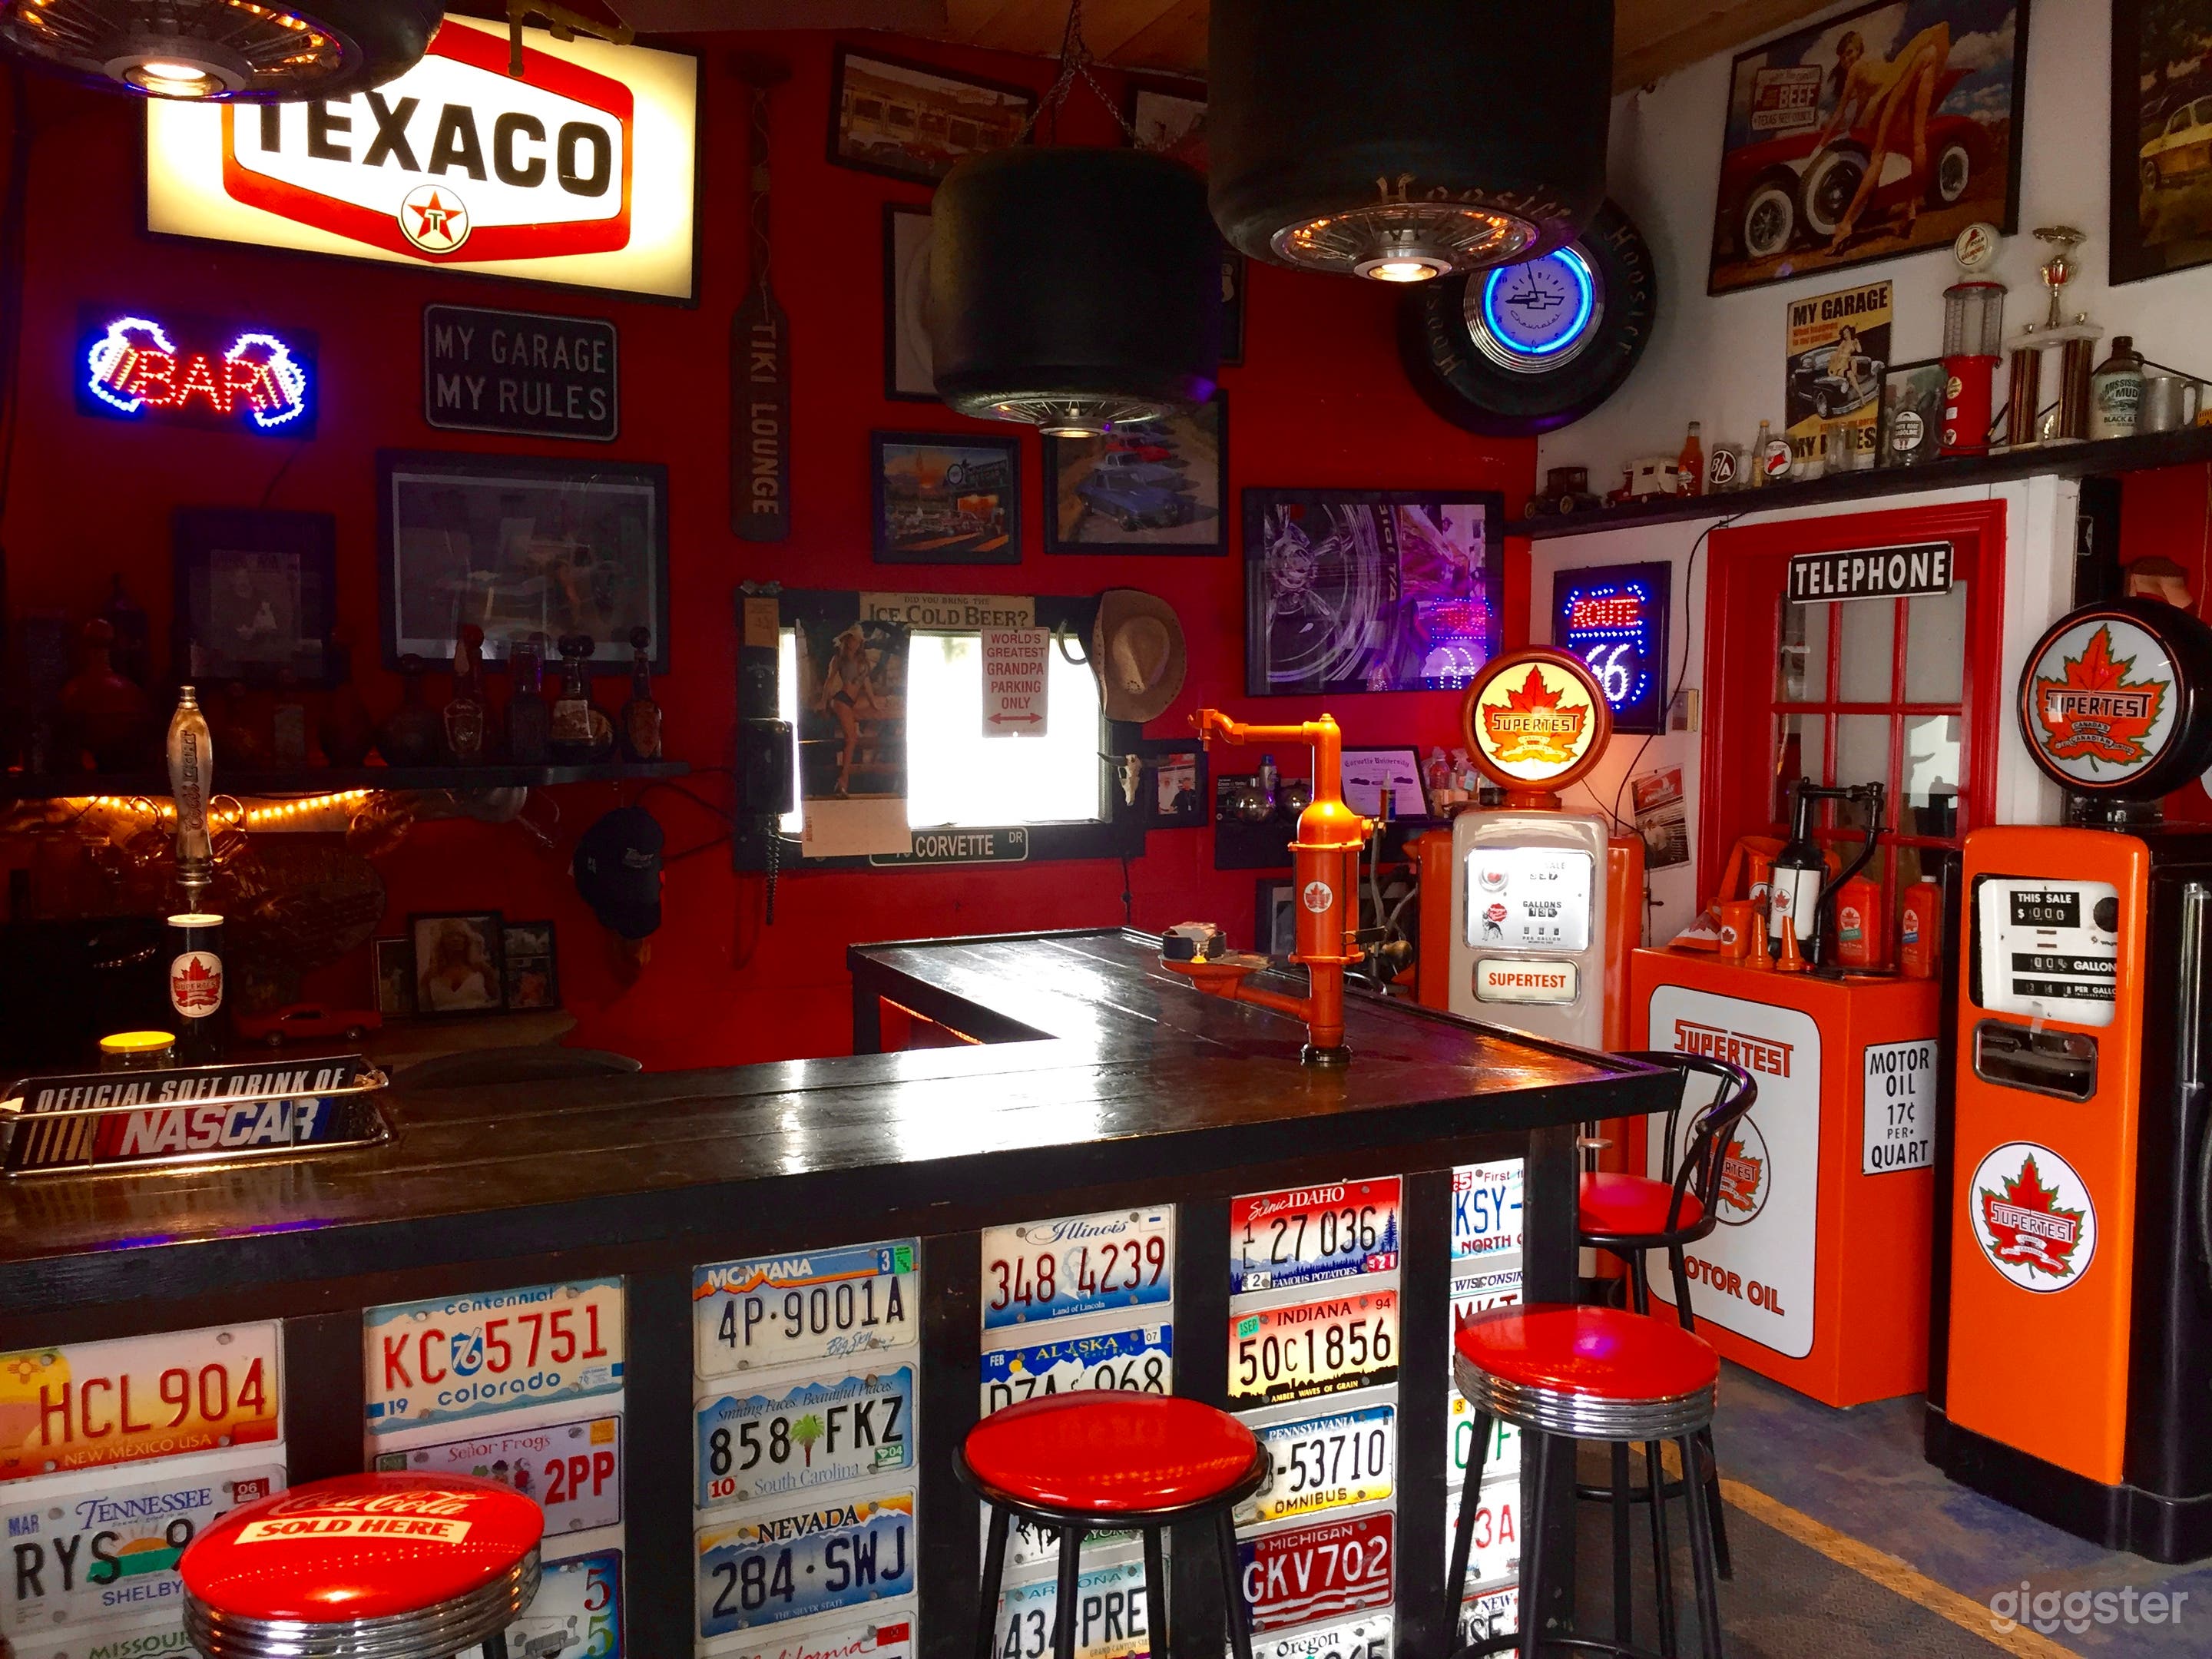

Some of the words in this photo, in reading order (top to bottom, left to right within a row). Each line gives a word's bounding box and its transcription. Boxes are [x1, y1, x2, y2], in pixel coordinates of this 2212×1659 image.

[1780, 84, 1817, 108] BEEF
[260, 91, 611, 197] TEXACO
[1793, 303, 1817, 326] MY
[1821, 286, 1887, 321] GARAGE
[435, 323, 475, 361] MY
[491, 328, 606, 374] GARAGE
[750, 320, 777, 383] TIKI
[138, 350, 264, 412] BAR
[2115, 389, 2137, 397] MUD
[437, 373, 486, 411] MY
[499, 378, 607, 421] RULES
[750, 402, 780, 515] LOUNGE
[1796, 551, 1945, 595] TELEPHONE
[942, 597, 969, 605] BRING
[1574, 598, 1638, 628] ROUTE
[869, 604, 900, 621] ICE
[906, 604, 959, 624] COLD
[965, 606, 1028, 628] BEER?
[991, 634, 1041, 644] WORLD'S
[987, 647, 1045, 658] GREATEST
[987, 663, 1043, 675] GRANDPA
[991, 680, 1041, 693] PARKING
[1002, 697, 1031, 710] ONLY
[1494, 714, 1579, 732] SUPERTEST
[916, 834, 994, 858] CORVETTE
[1008, 831, 1023, 843] DR
[2018, 893, 2041, 903] THIS
[2046, 893, 2071, 904] SALE
[1488, 972, 1566, 988] SUPERTEST
[1674, 1019, 1794, 1078] SUPERTEST
[1870, 1048, 1929, 1075] MOTOR
[36, 1088, 149, 1113] OFFICIAL
[159, 1077, 217, 1103] SOFT
[230, 1071, 309, 1098] DRINK
[314, 1068, 346, 1091] OF
[1886, 1074, 1916, 1096] OIL
[120, 1098, 321, 1156] NASCAR
[1887, 1102, 1915, 1126] 17¢
[1872, 1140, 1929, 1169] QUART
[1459, 1173, 1472, 1190] 5
[1484, 1171, 1510, 1183] First
[1288, 1187, 1345, 1209] IDAHO
[1025, 1217, 1128, 1246] Illinois
[1270, 1214, 1309, 1265] 27
[1320, 1206, 1376, 1257] 036
[1992, 1202, 2075, 1243] SUPERTEST
[1462, 1235, 1512, 1254] NORTH
[708, 1259, 813, 1287] MONTANA
[881, 1250, 890, 1271] 3
[990, 1253, 1055, 1310] 348
[1078, 1236, 1164, 1298] 4239
[1253, 1274, 1260, 1287] 2
[1273, 1273, 1310, 1288] FAMOUS
[1312, 1266, 1358, 1282] POTATOES
[1684, 1255, 1743, 1299] OTOR
[1747, 1280, 1785, 1316] OIL
[444, 1286, 554, 1316] centennial
[1052, 1306, 1070, 1316] Land
[1071, 1305, 1078, 1313] of
[1080, 1301, 1105, 1313] Lincoln
[1277, 1301, 1352, 1326] INDIANA
[1376, 1297, 1391, 1310] 94
[383, 1328, 447, 1392] KC
[485, 1305, 608, 1373] 5751
[1146, 1332, 1157, 1343] 07
[990, 1355, 1005, 1367] FEB
[389, 1398, 409, 1416] 19
[438, 1372, 561, 1406] colorado
[717, 1404, 763, 1422] Smiling
[766, 1399, 798, 1413] Faces.
[803, 1384, 855, 1404] Beautiful
[859, 1380, 894, 1398] Places.
[1271, 1392, 1295, 1402] AMBER
[1298, 1387, 1321, 1398] WAVES
[1323, 1384, 1333, 1392] OF
[1336, 1380, 1358, 1391] GRAIN
[710, 1416, 790, 1475] 858
[826, 1395, 904, 1454] FKZ
[1268, 1416, 1355, 1441] PENNSYLVANIA
[65, 1451, 103, 1466] NEW
[109, 1439, 174, 1459] MEXICO
[180, 1434, 212, 1449] USA
[889, 1445, 902, 1456] 04
[238, 1483, 257, 1495] 06
[711, 1478, 735, 1498] 10
[754, 1472, 796, 1495] South
[800, 1463, 859, 1485] Carolina
[76, 1488, 212, 1530] TENNESSEE
[1275, 1488, 1347, 1514] OMNIBUS
[8, 1514, 38, 1536] MAR
[257, 1520, 352, 1536] SOLD
[358, 1519, 454, 1537] HERE
[757, 1505, 859, 1544] NEVADA
[1270, 1526, 1353, 1552] MICHIGAN
[13, 1531, 119, 1600] RYS
[712, 1548, 795, 1619] 284
[825, 1526, 905, 1592] SWJ
[1243, 1535, 1388, 1604] GKV702
[102, 1580, 183, 1606] SHELBY
[1482, 1594, 1512, 1610] NEW
[1090, 1647, 1111, 1657] GRAND
[1112, 1641, 1137, 1652] CANYON
[1277, 1630, 1339, 1659] Oregon
